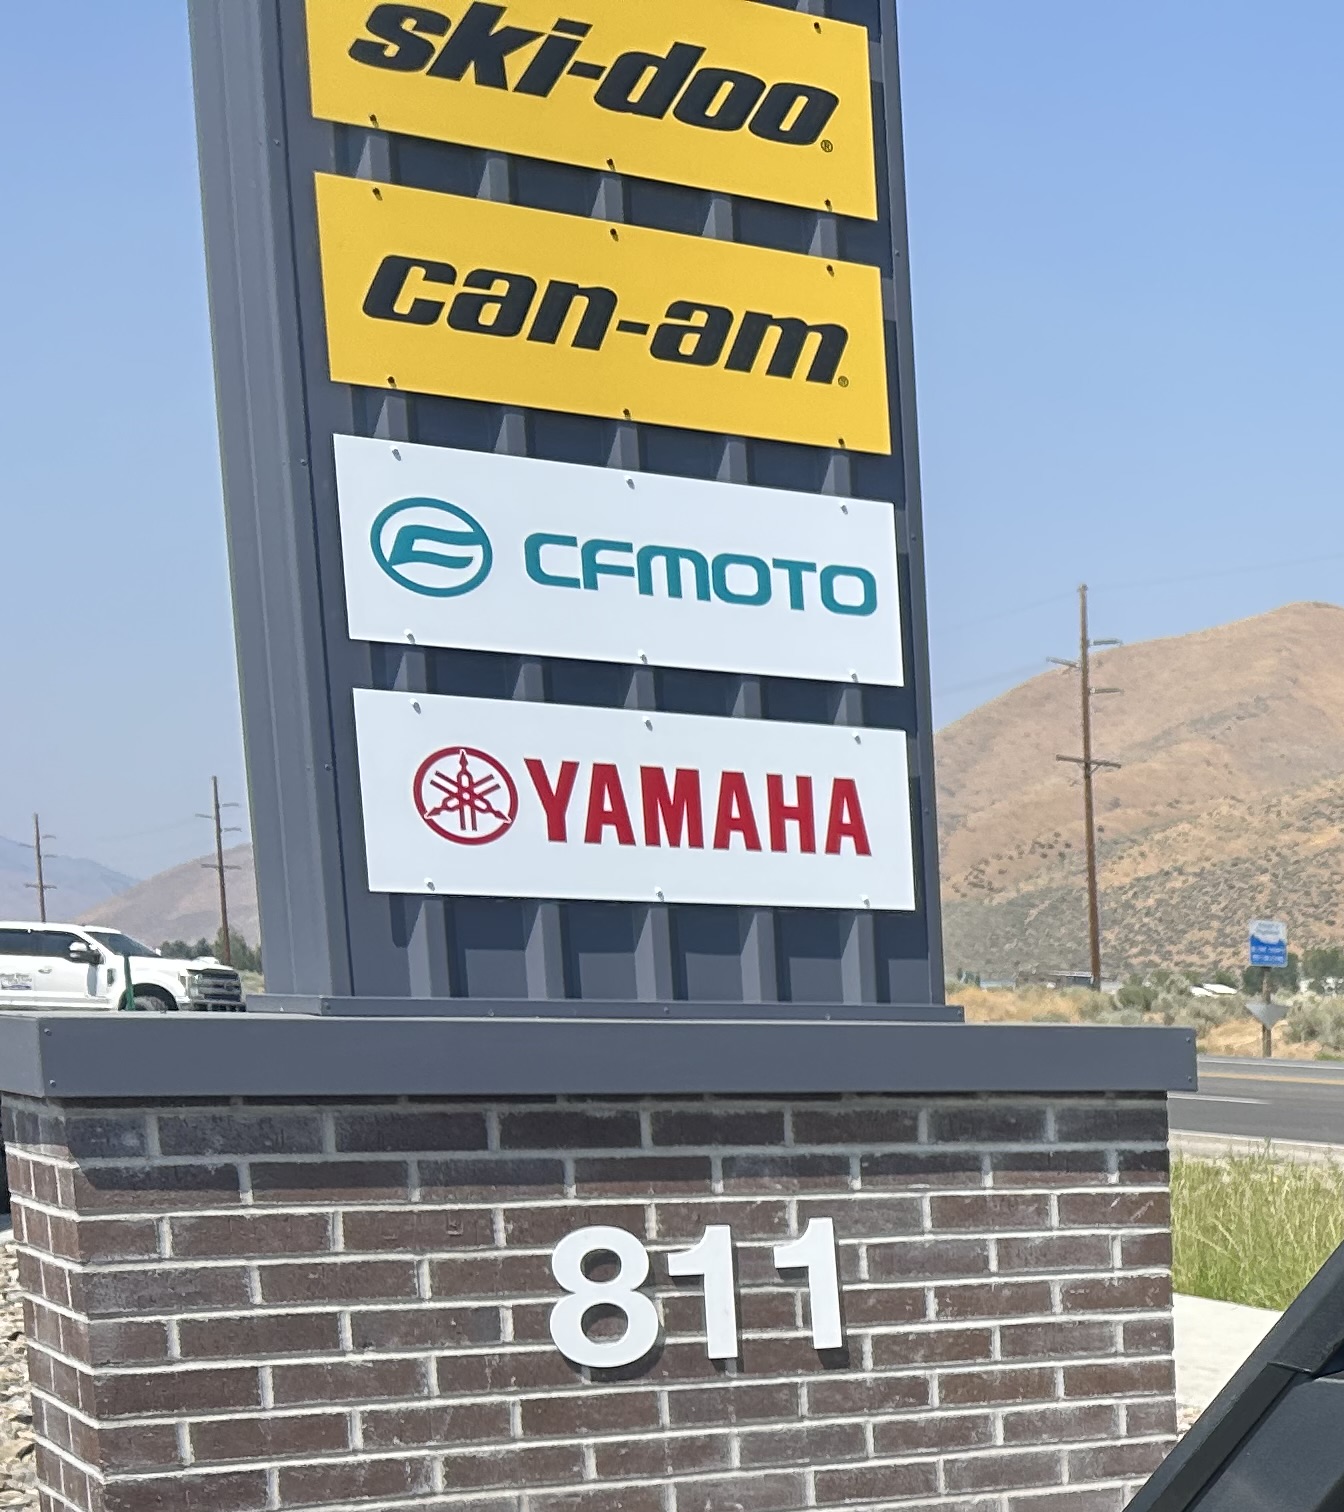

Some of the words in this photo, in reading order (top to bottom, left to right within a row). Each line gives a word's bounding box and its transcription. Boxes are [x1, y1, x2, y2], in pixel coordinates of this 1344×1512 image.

[348, 0, 840, 146] ski-doo
[362, 254, 849, 385] can-am
[523, 532, 878, 617] CFMOTO
[523, 758, 872, 857] YAMAHA
[549, 1216, 843, 1368] 811
